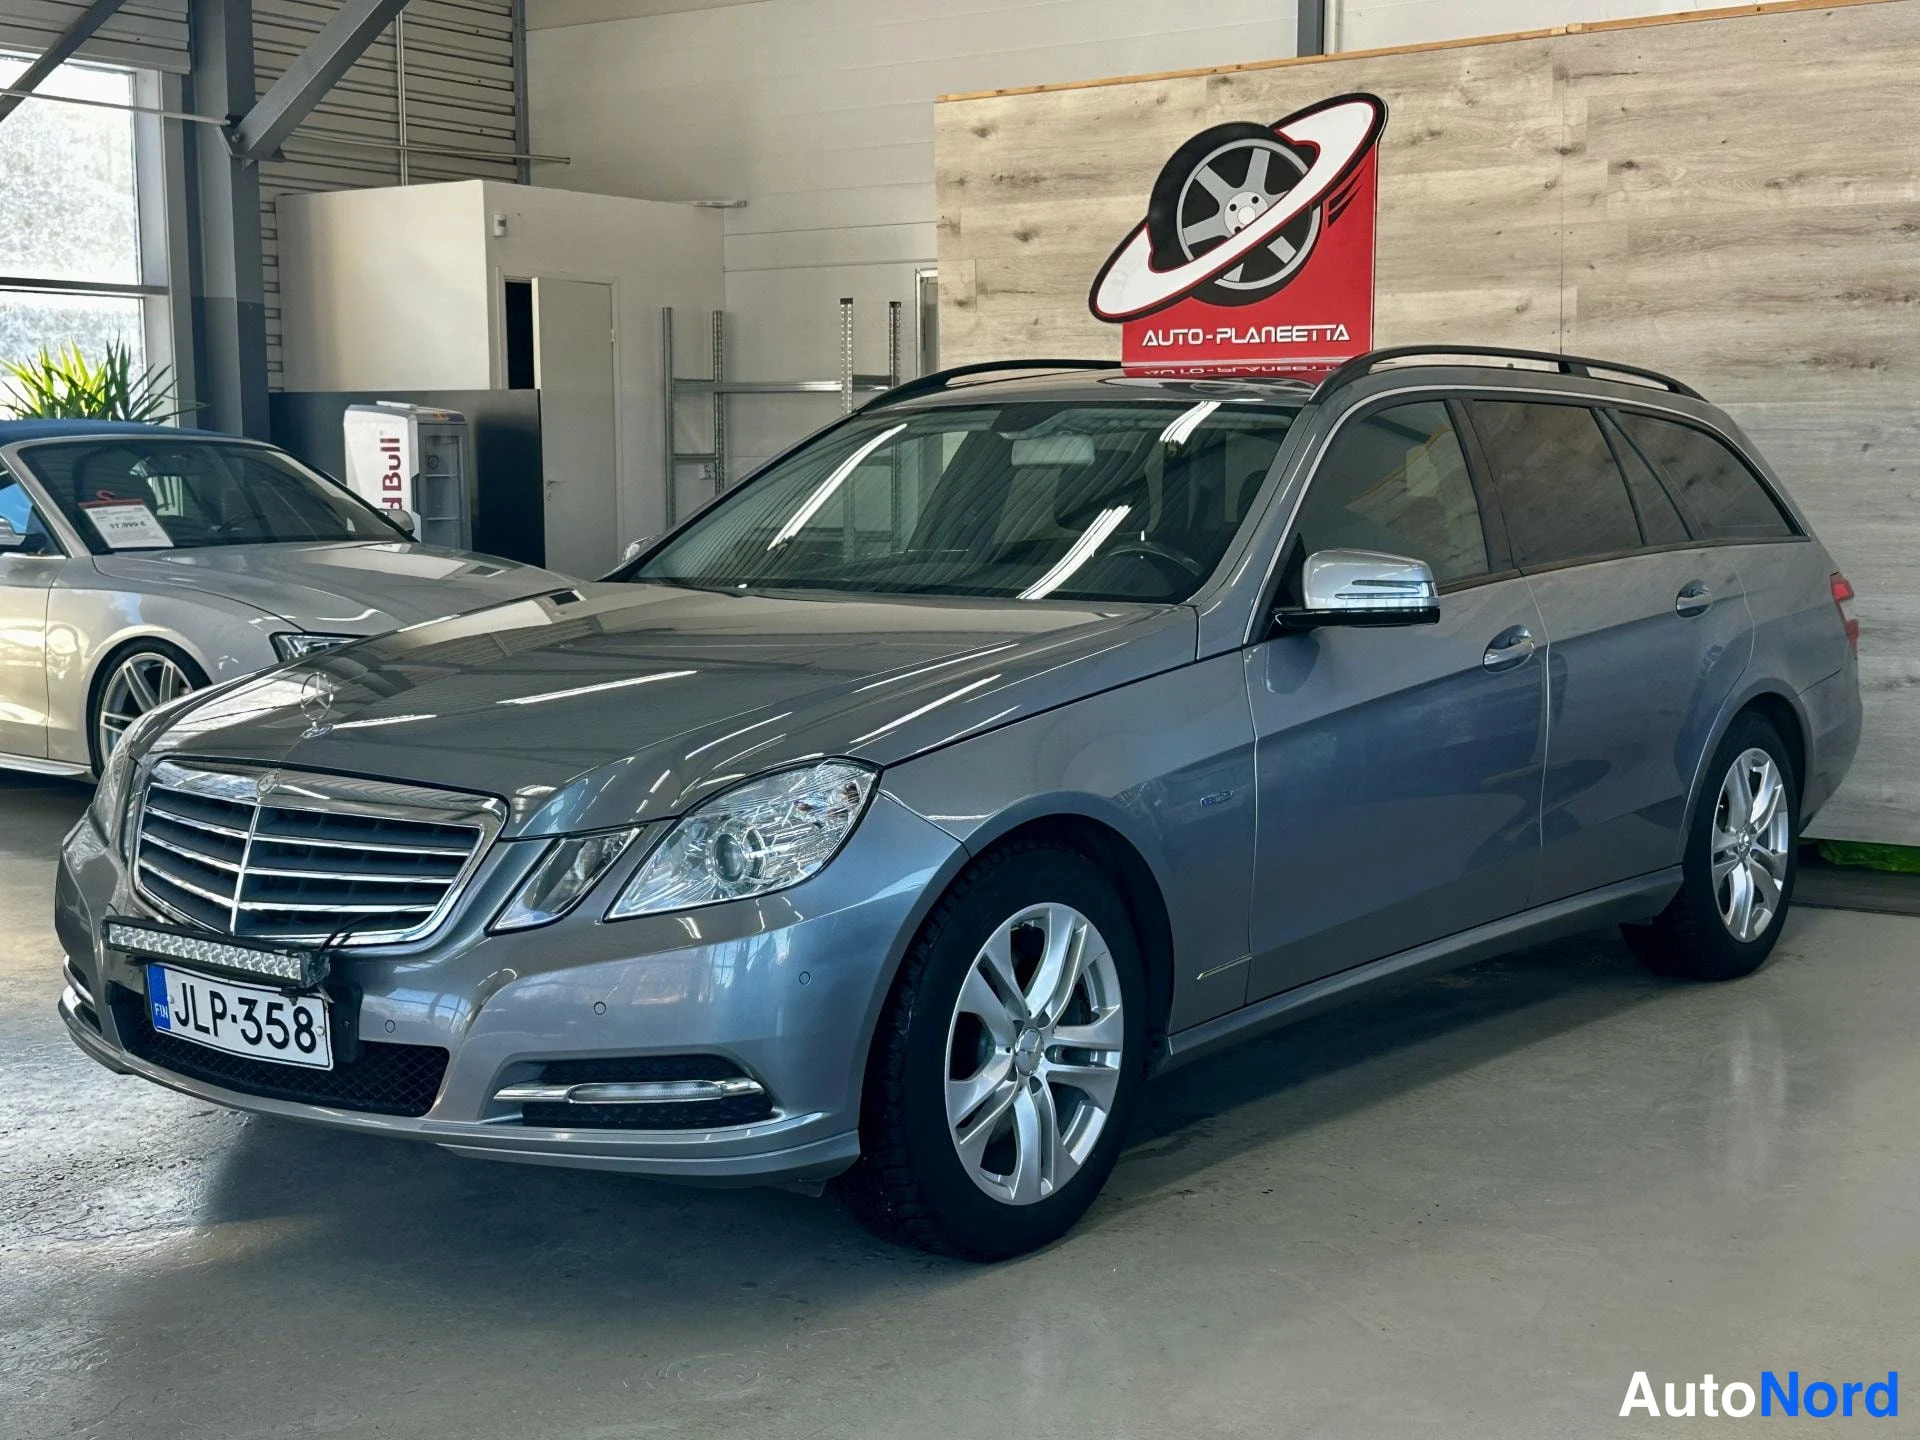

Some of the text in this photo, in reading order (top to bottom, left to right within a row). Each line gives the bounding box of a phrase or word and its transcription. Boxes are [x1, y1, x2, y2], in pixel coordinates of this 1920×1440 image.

[1141, 324, 1350, 347] AUTO-PLANEETTA
[379, 437, 402, 491] Bull
[153, 1002, 169, 1020] FIN
[173, 982, 318, 1054] JLP-358
